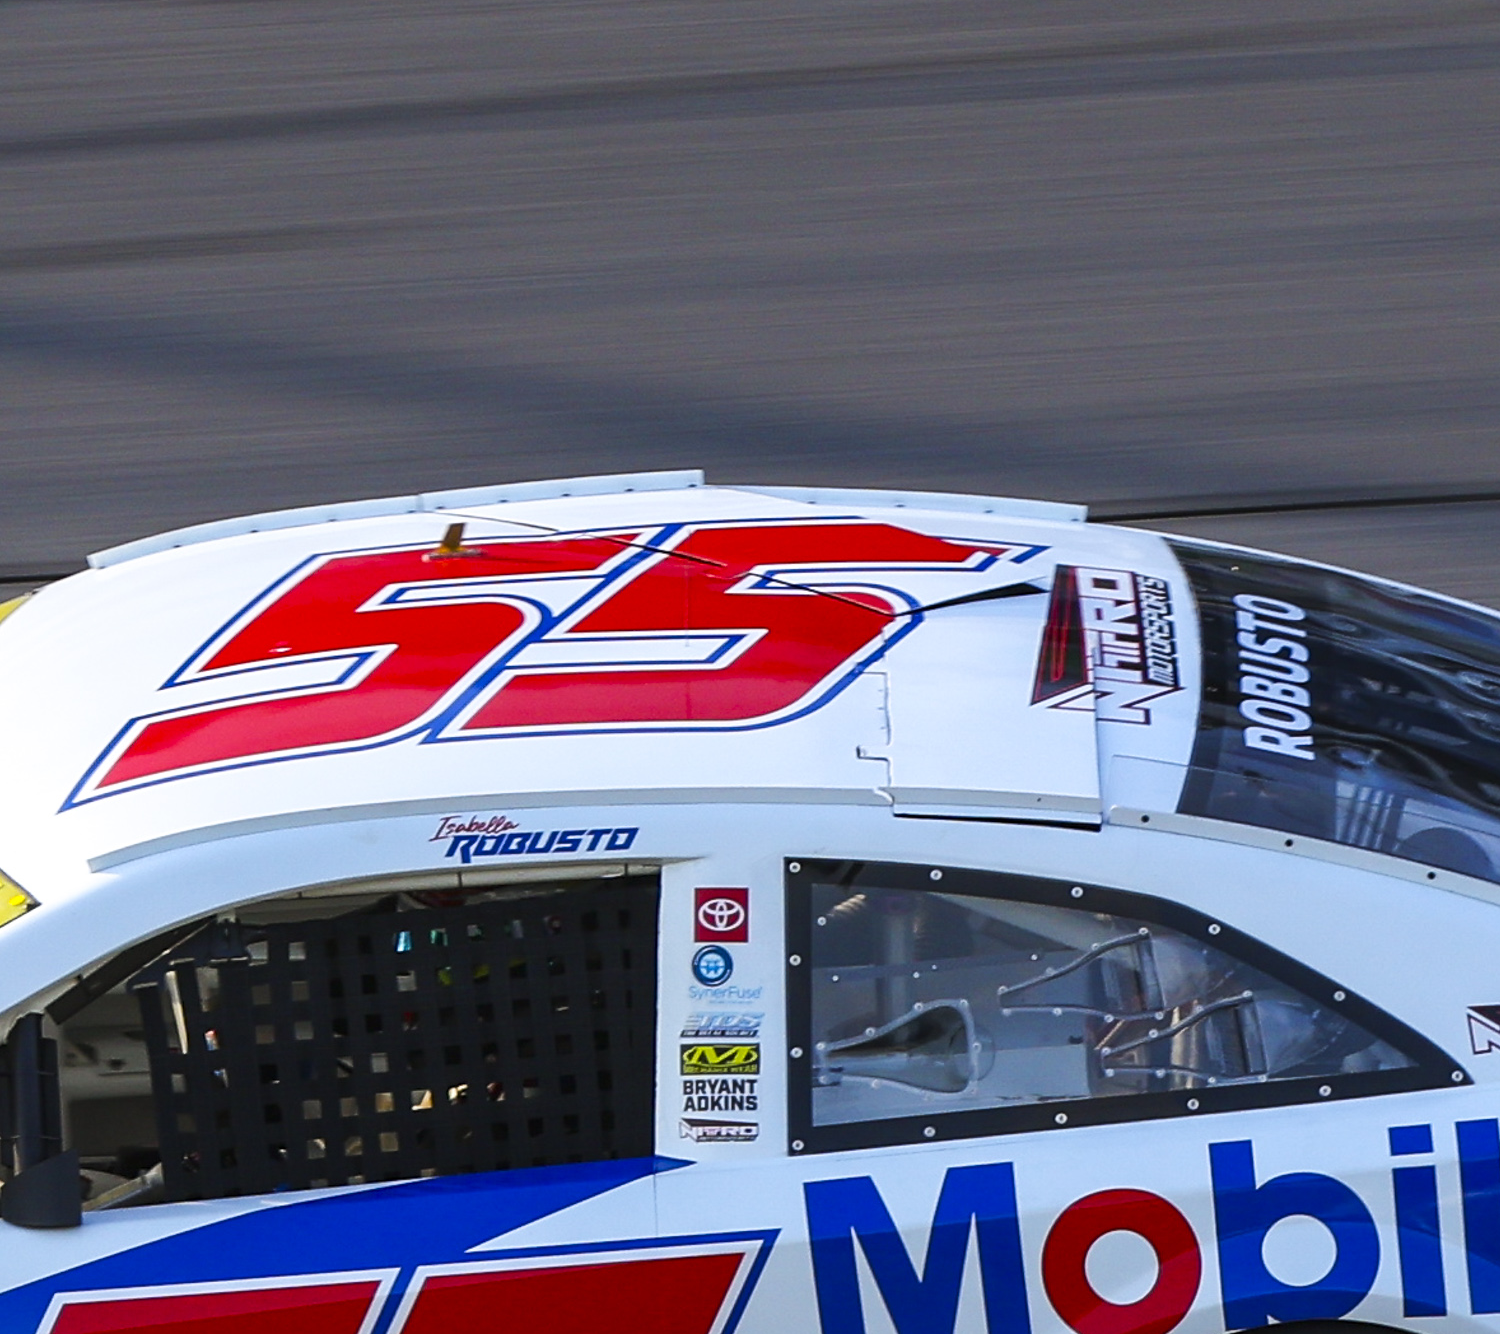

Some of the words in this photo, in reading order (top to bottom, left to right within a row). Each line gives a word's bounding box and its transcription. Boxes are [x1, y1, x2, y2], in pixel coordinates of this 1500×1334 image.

[58, 515, 1046, 813] 55
[1047, 567, 1184, 724] NITRO
[1135, 574, 1179, 687] MOTORSPORTS
[1233, 594, 1316, 761] ROBUSTO
[429, 815, 521, 842] Isabella
[445, 827, 640, 864] ROBUSTO
[683, 1079, 757, 1095] BRYANT
[684, 1096, 758, 1111] ADKINS
